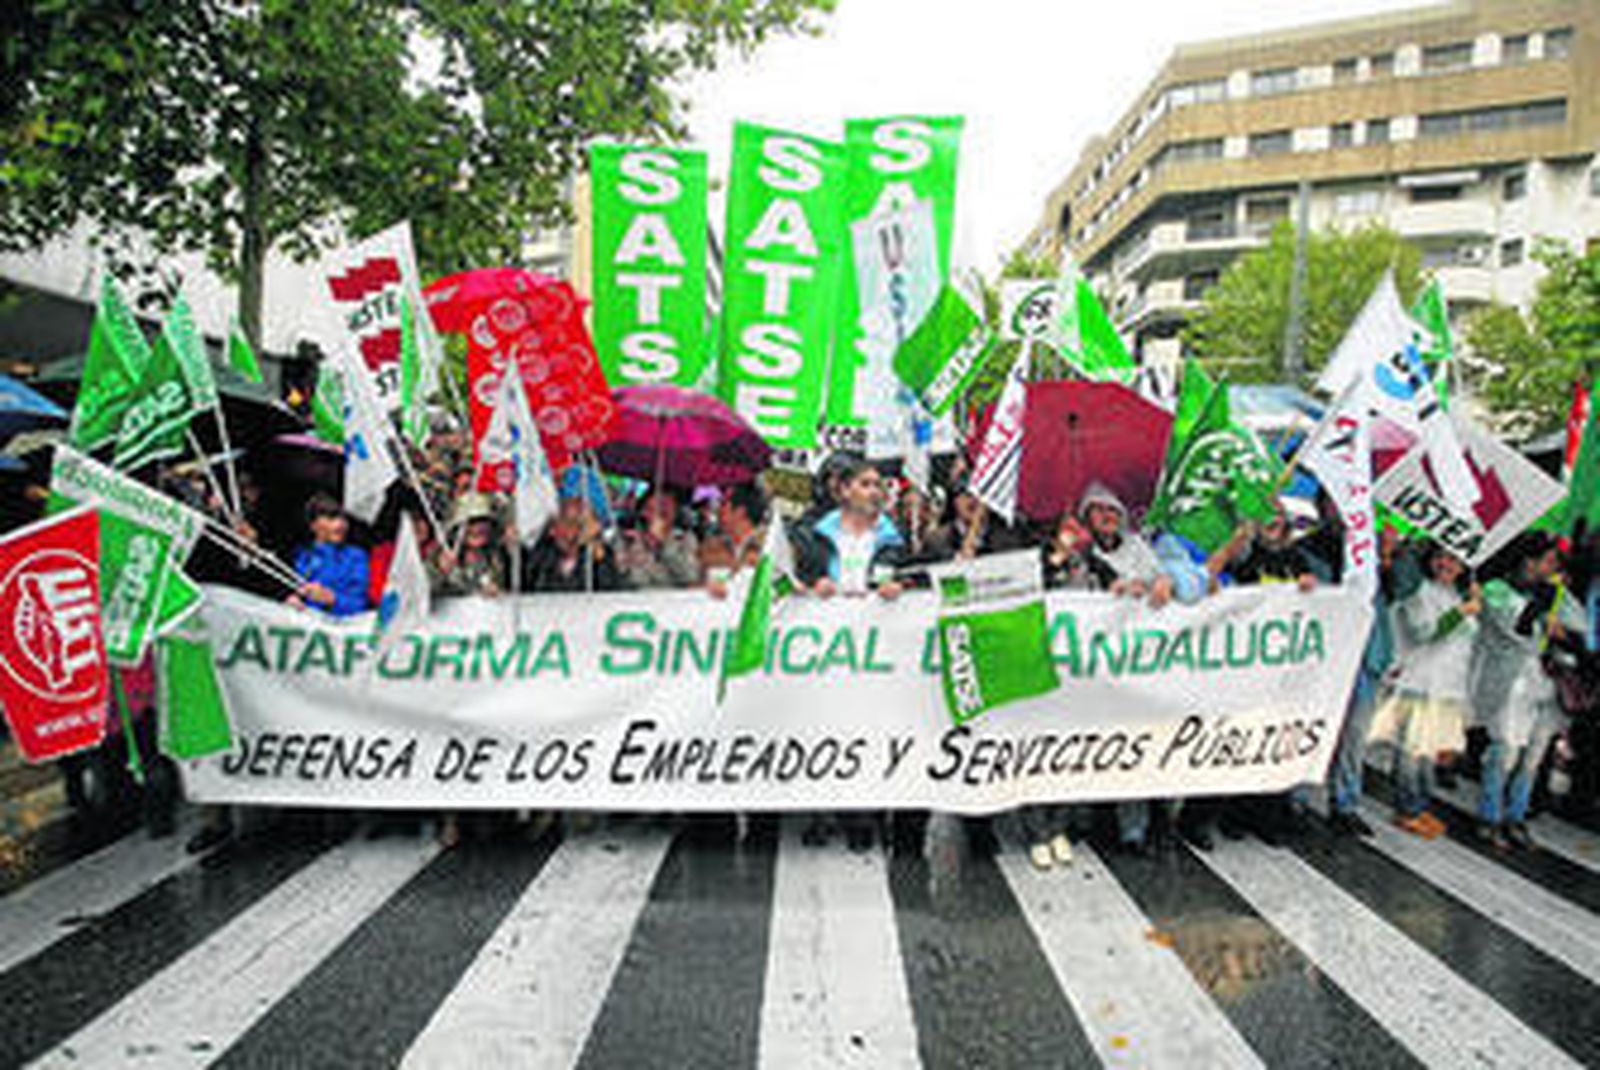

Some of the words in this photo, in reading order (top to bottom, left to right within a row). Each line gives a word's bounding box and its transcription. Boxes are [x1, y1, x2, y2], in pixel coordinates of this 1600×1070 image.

[612, 151, 688, 383] SATS
[734, 136, 823, 439] SATSE
[1392, 484, 1486, 559] USTEA
[215, 624, 572, 681] ATAFORMA
[601, 610, 894, 676] SINICAL
[1048, 610, 1327, 680] ANDALUCÍA
[433, 737, 498, 784] DE
[505, 738, 594, 784] LOS
[609, 720, 867, 784] EMPLEADOS
[883, 738, 914, 781] Y
[927, 724, 1151, 786] SERVICIOS
